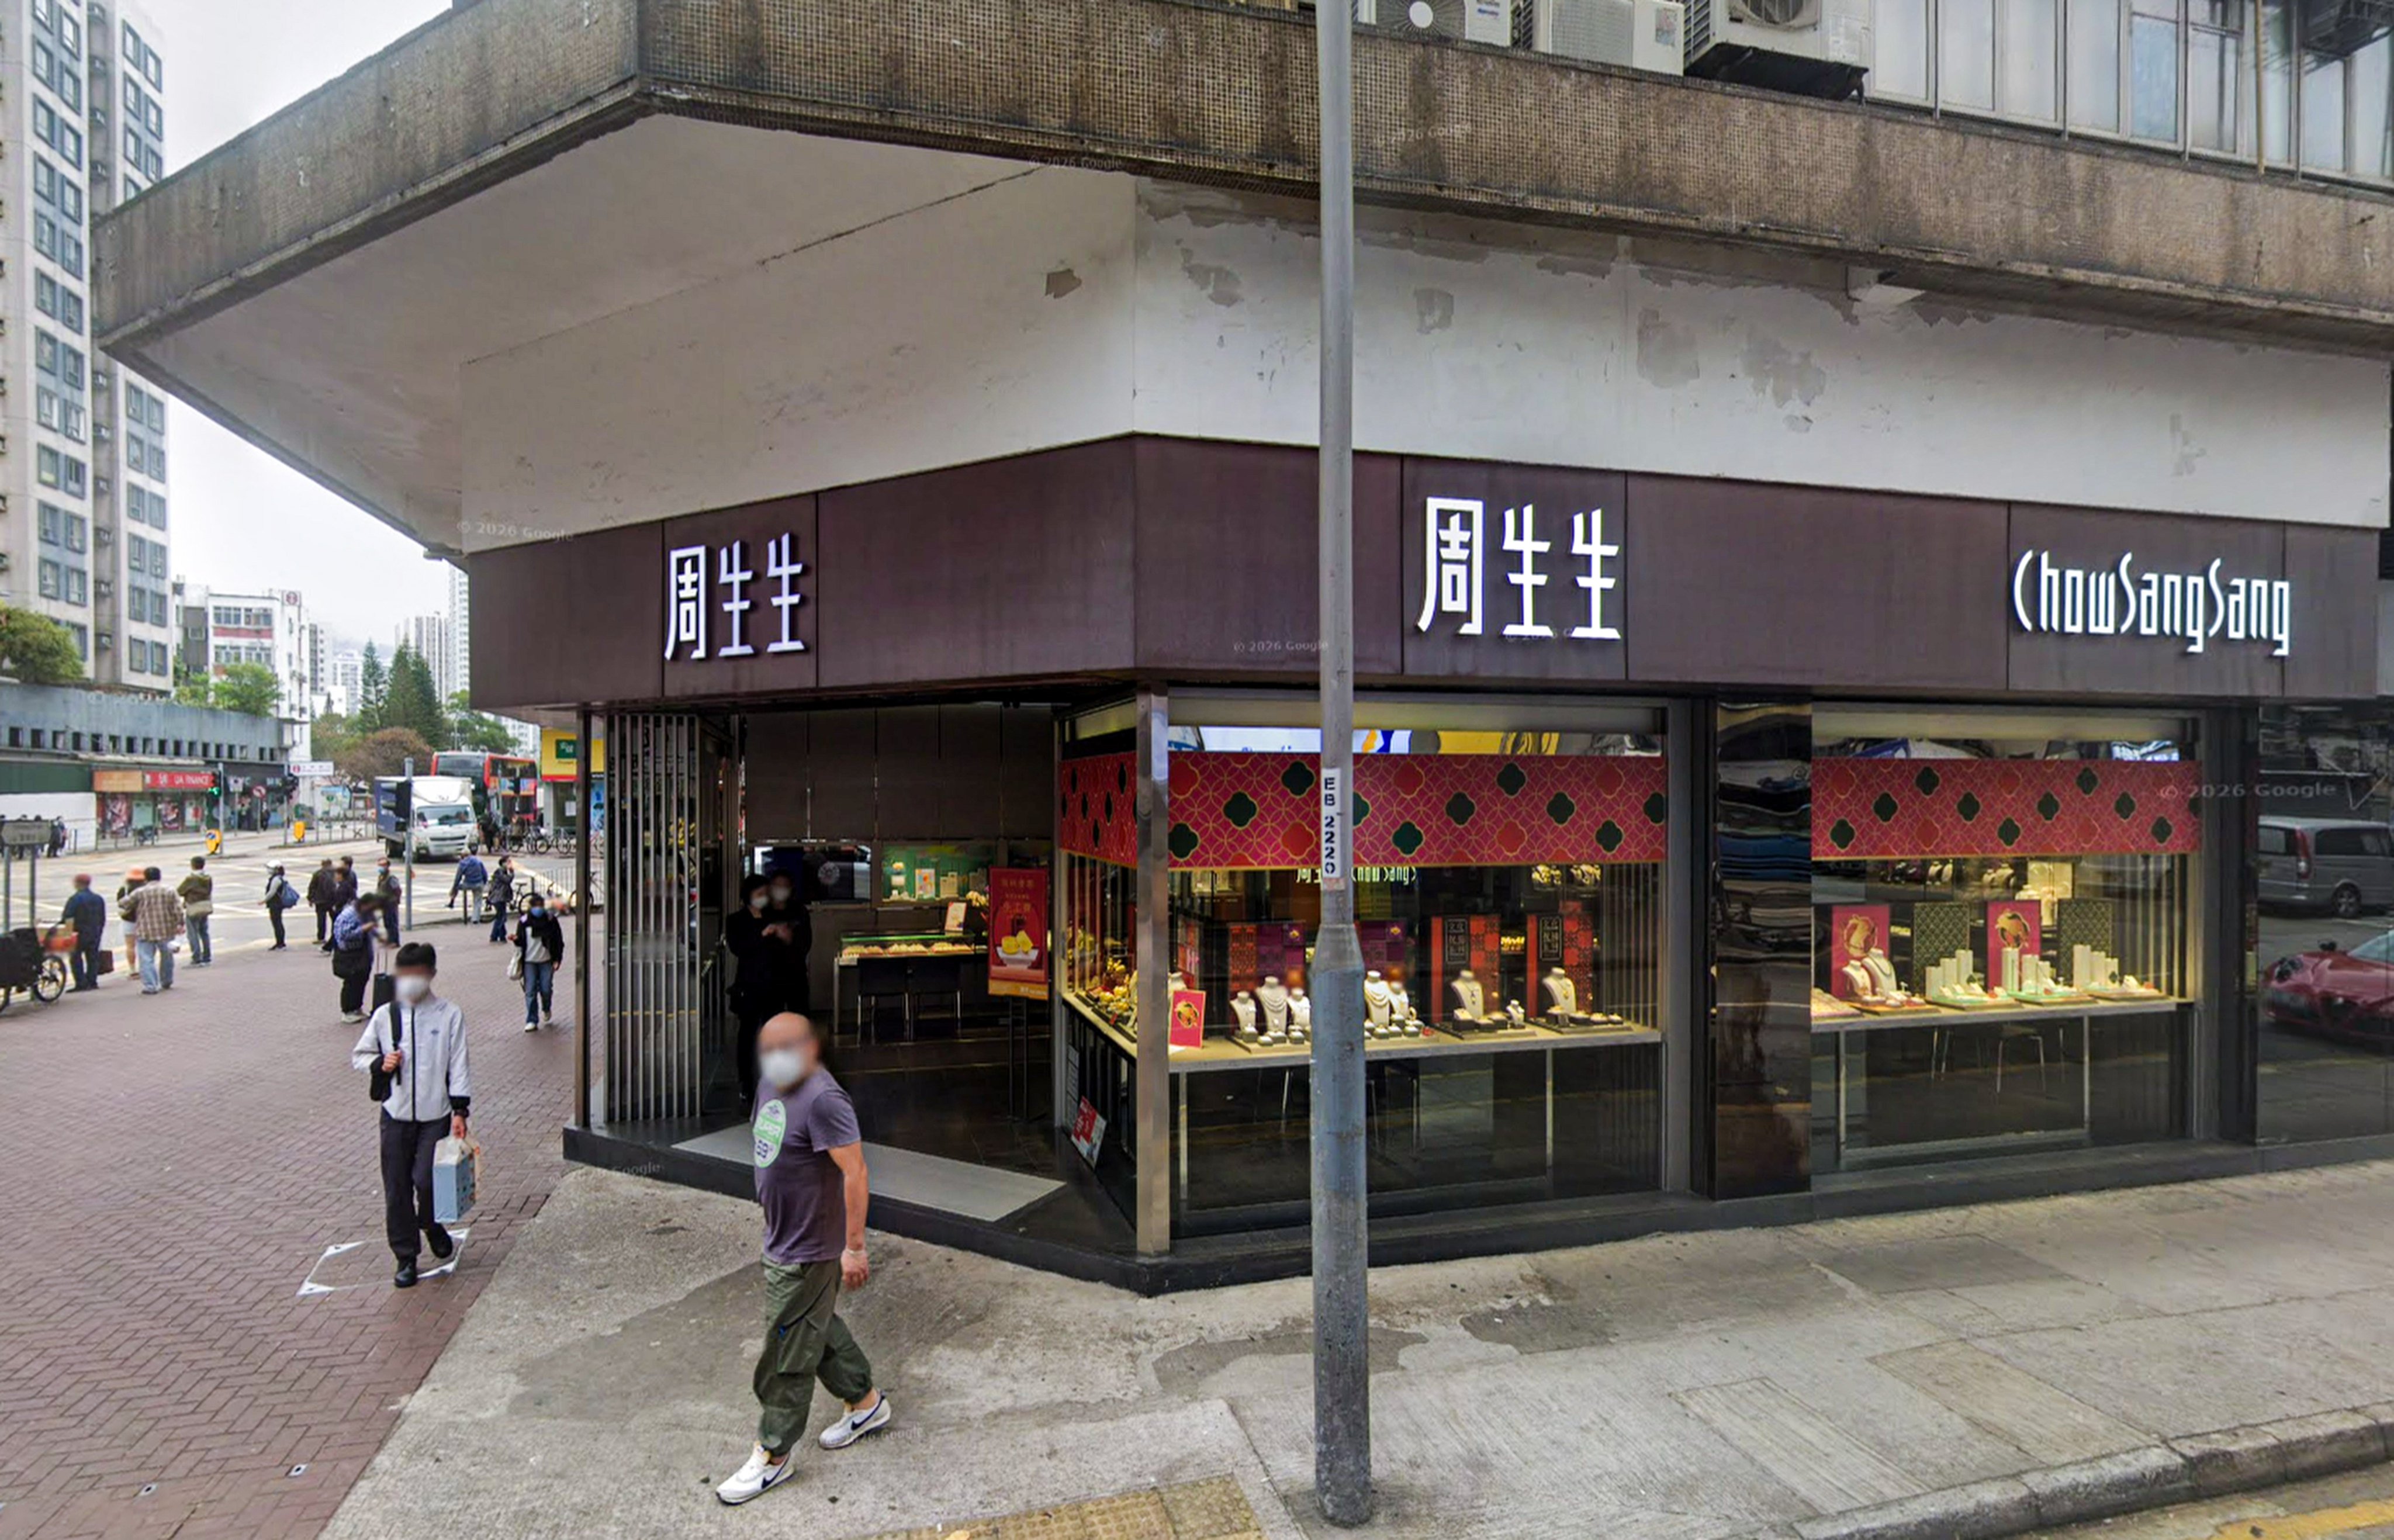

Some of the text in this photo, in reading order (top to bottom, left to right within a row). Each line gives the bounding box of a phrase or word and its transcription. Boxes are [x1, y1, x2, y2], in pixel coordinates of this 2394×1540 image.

[665, 532, 805, 660] 周生生
[1417, 497, 1621, 639] 周生生
[1324, 777, 1336, 874] EB 2220
